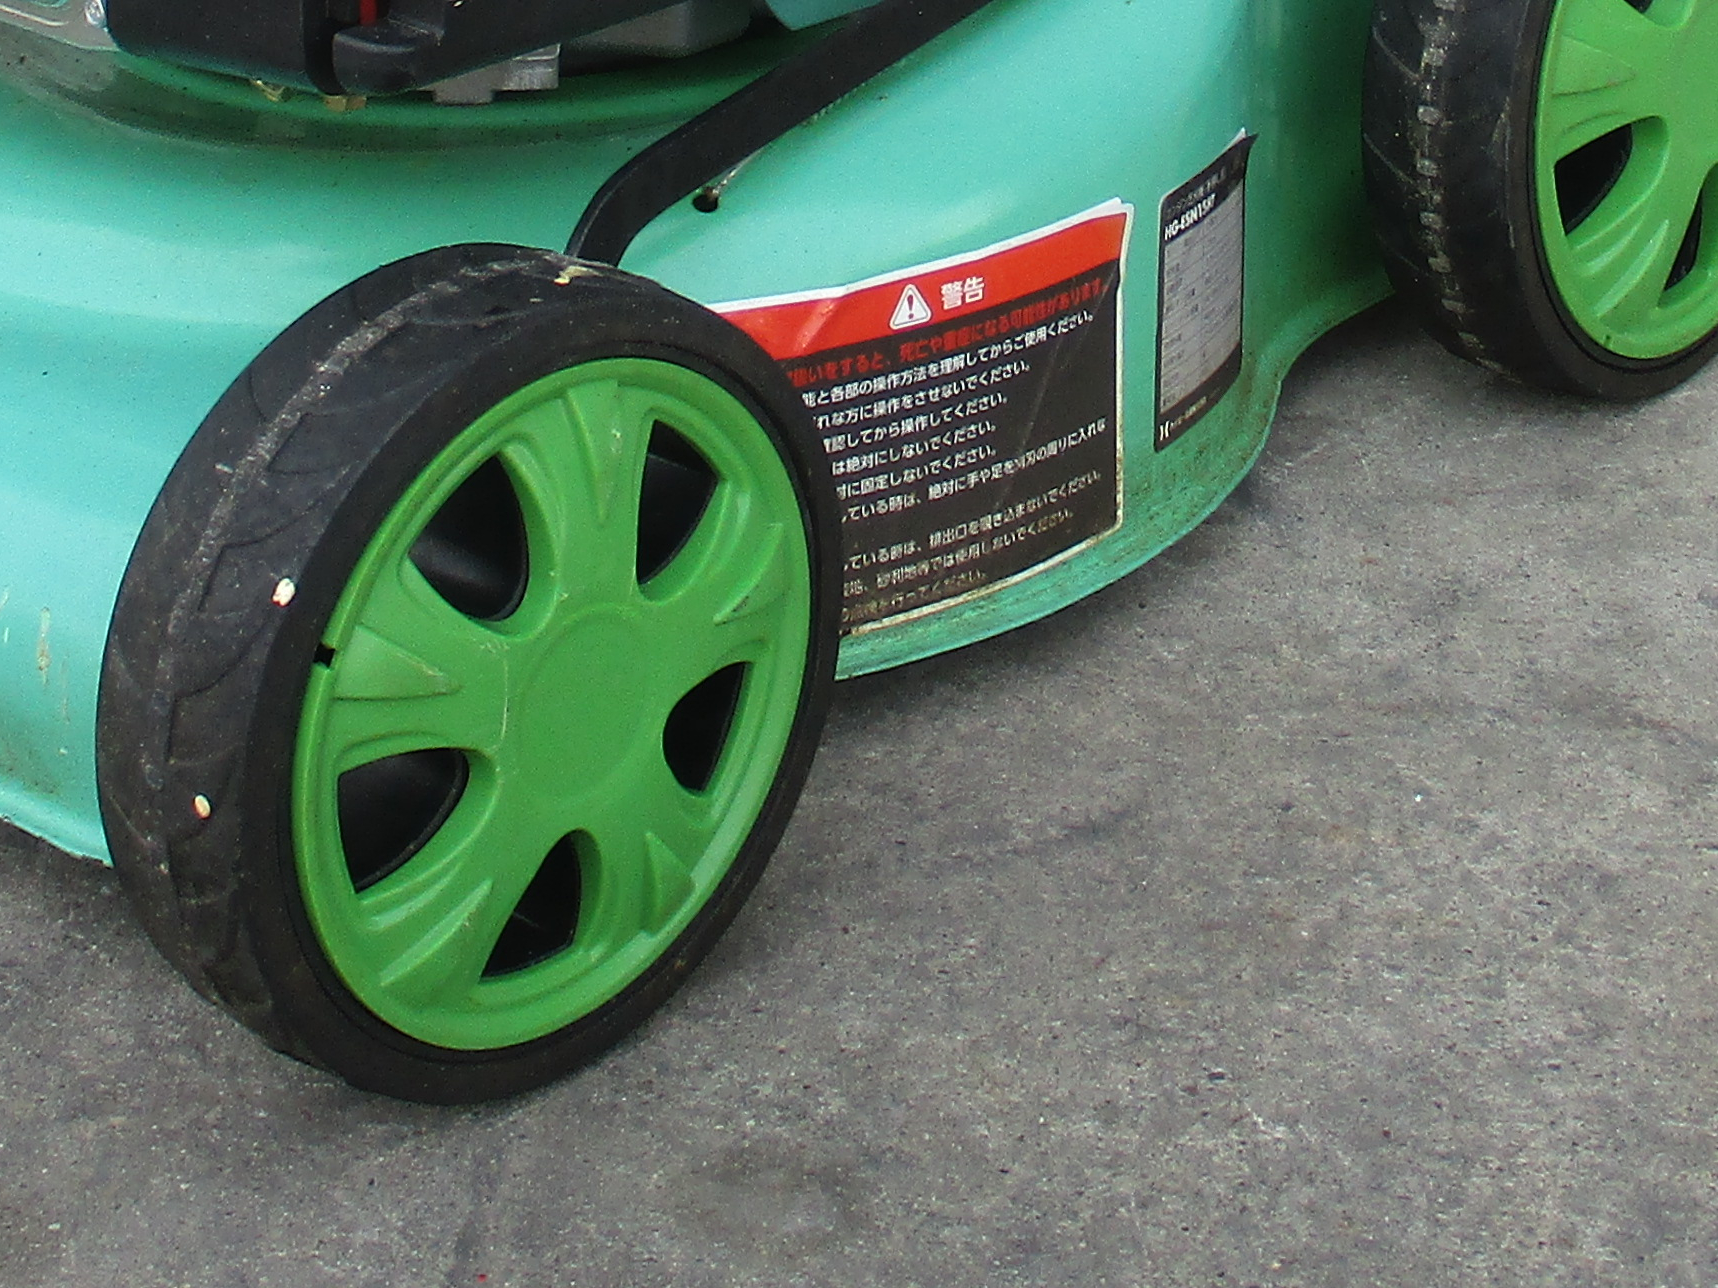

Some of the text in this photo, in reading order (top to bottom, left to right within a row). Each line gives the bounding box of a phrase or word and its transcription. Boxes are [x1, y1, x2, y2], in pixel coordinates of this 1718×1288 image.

[940, 276, 985, 311] 警告
[812, 360, 1031, 430] れな方に操作をさせないでください。
